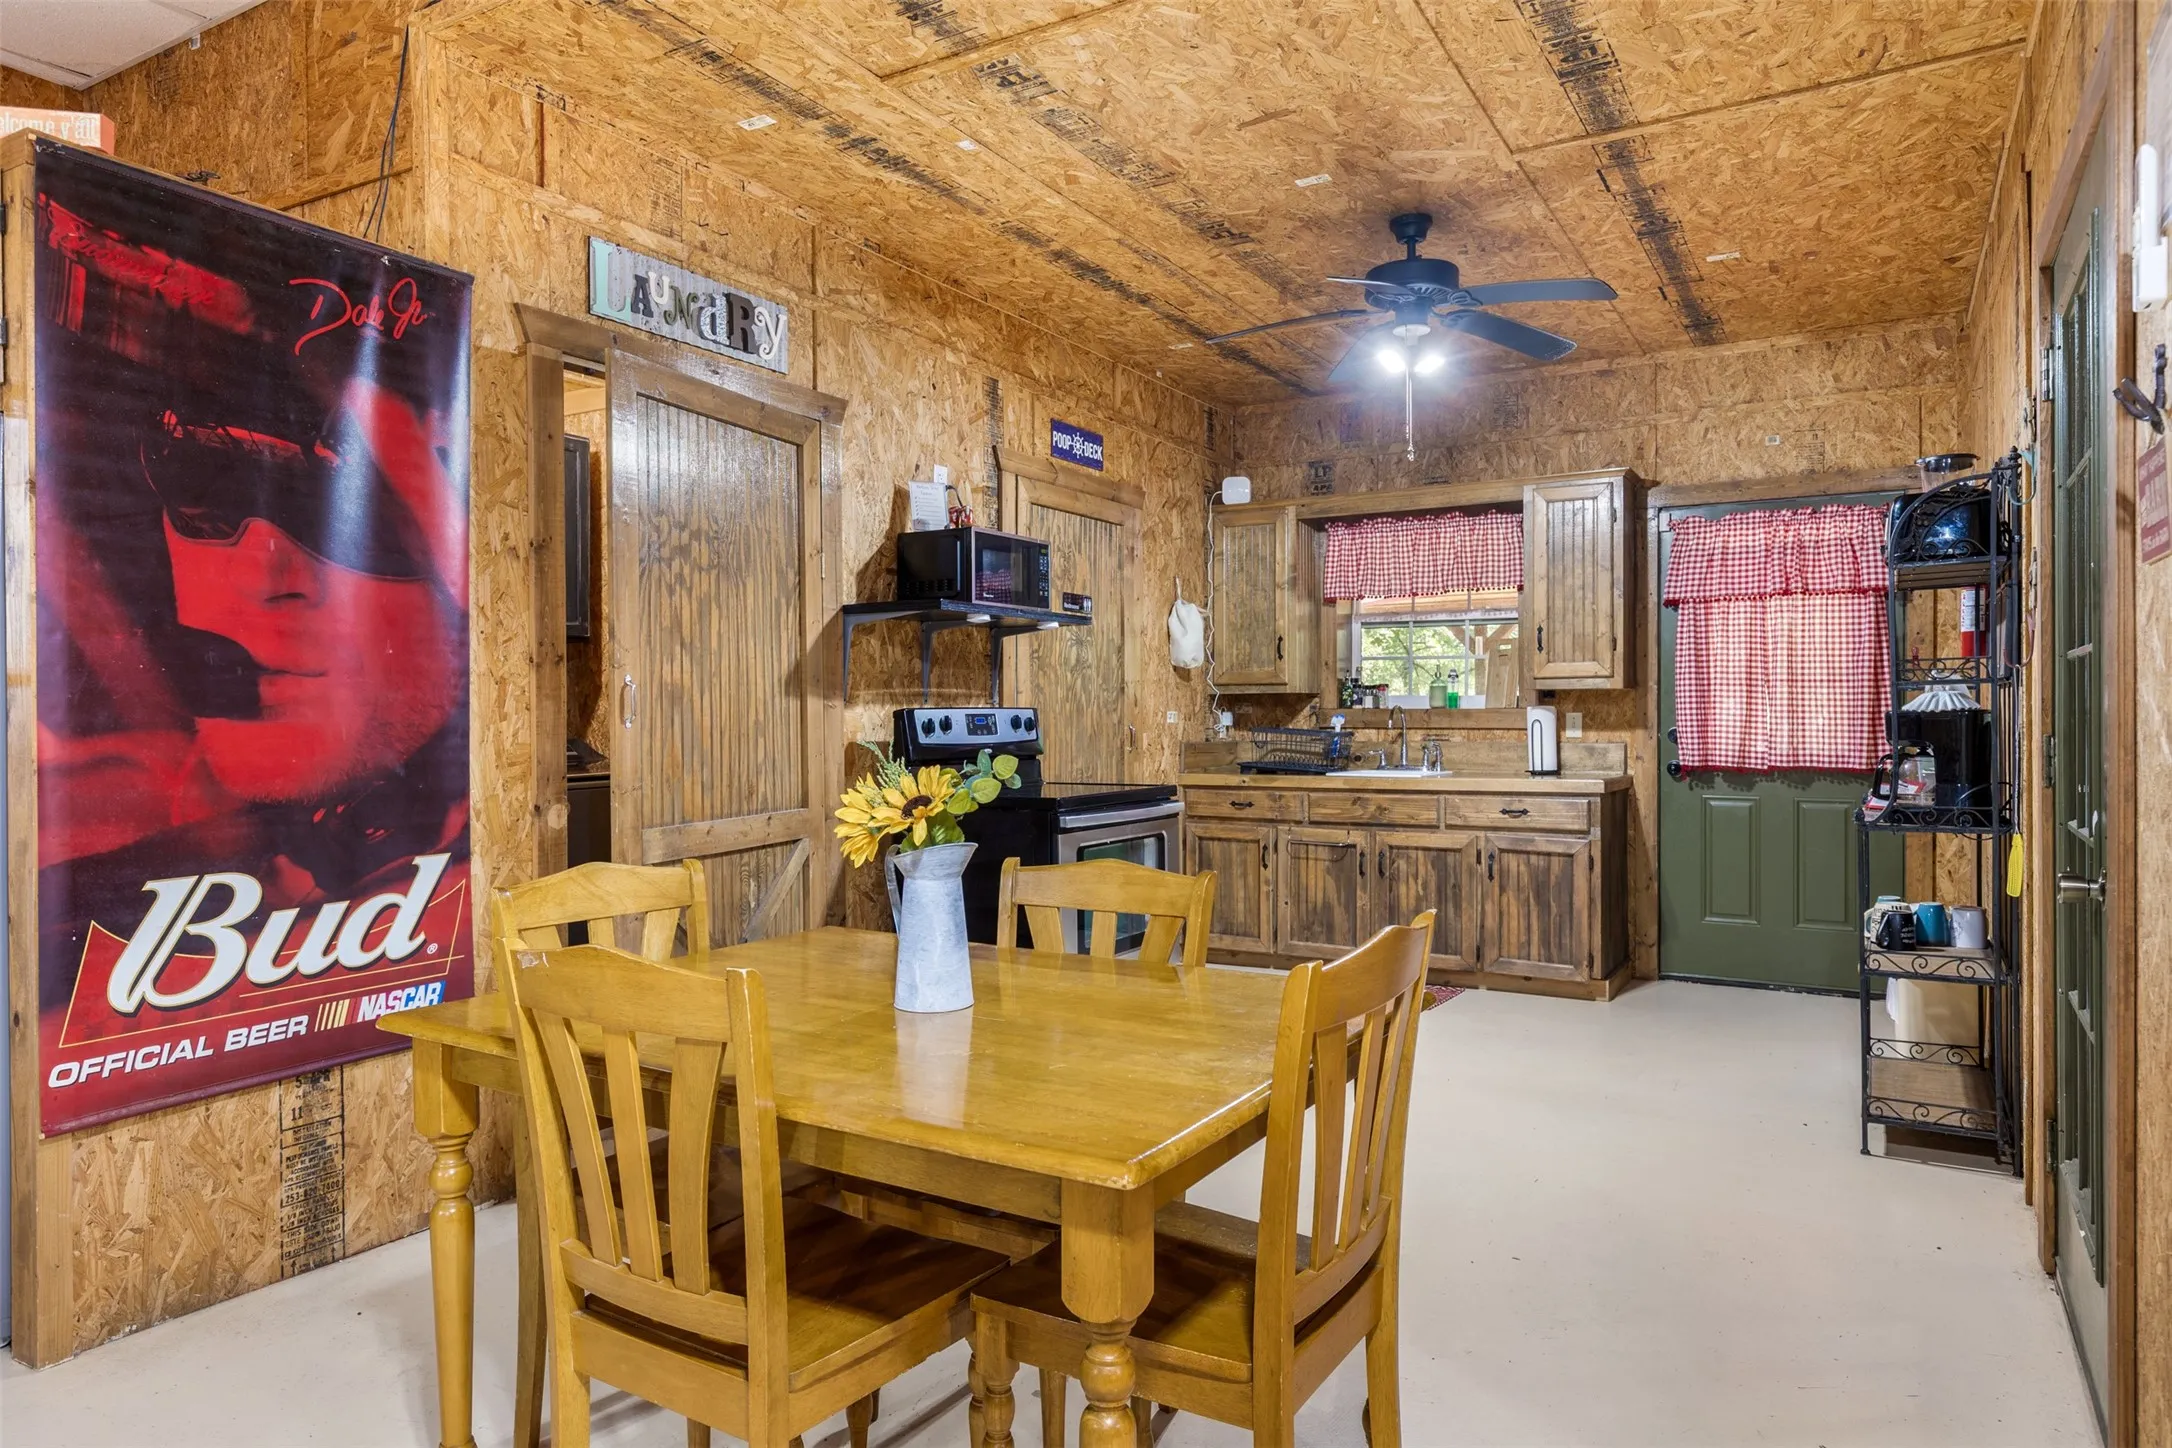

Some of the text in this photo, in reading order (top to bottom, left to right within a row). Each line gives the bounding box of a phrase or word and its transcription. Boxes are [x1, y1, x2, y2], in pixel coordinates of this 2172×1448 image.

[289, 279, 384, 355] Dale
[1052, 430, 1103, 461] POOP DECK
[107, 852, 451, 1013] Bud
[47, 981, 441, 1089] OFFICIAL BEER NASCAR
[287, 1229, 301, 1239] THIS
